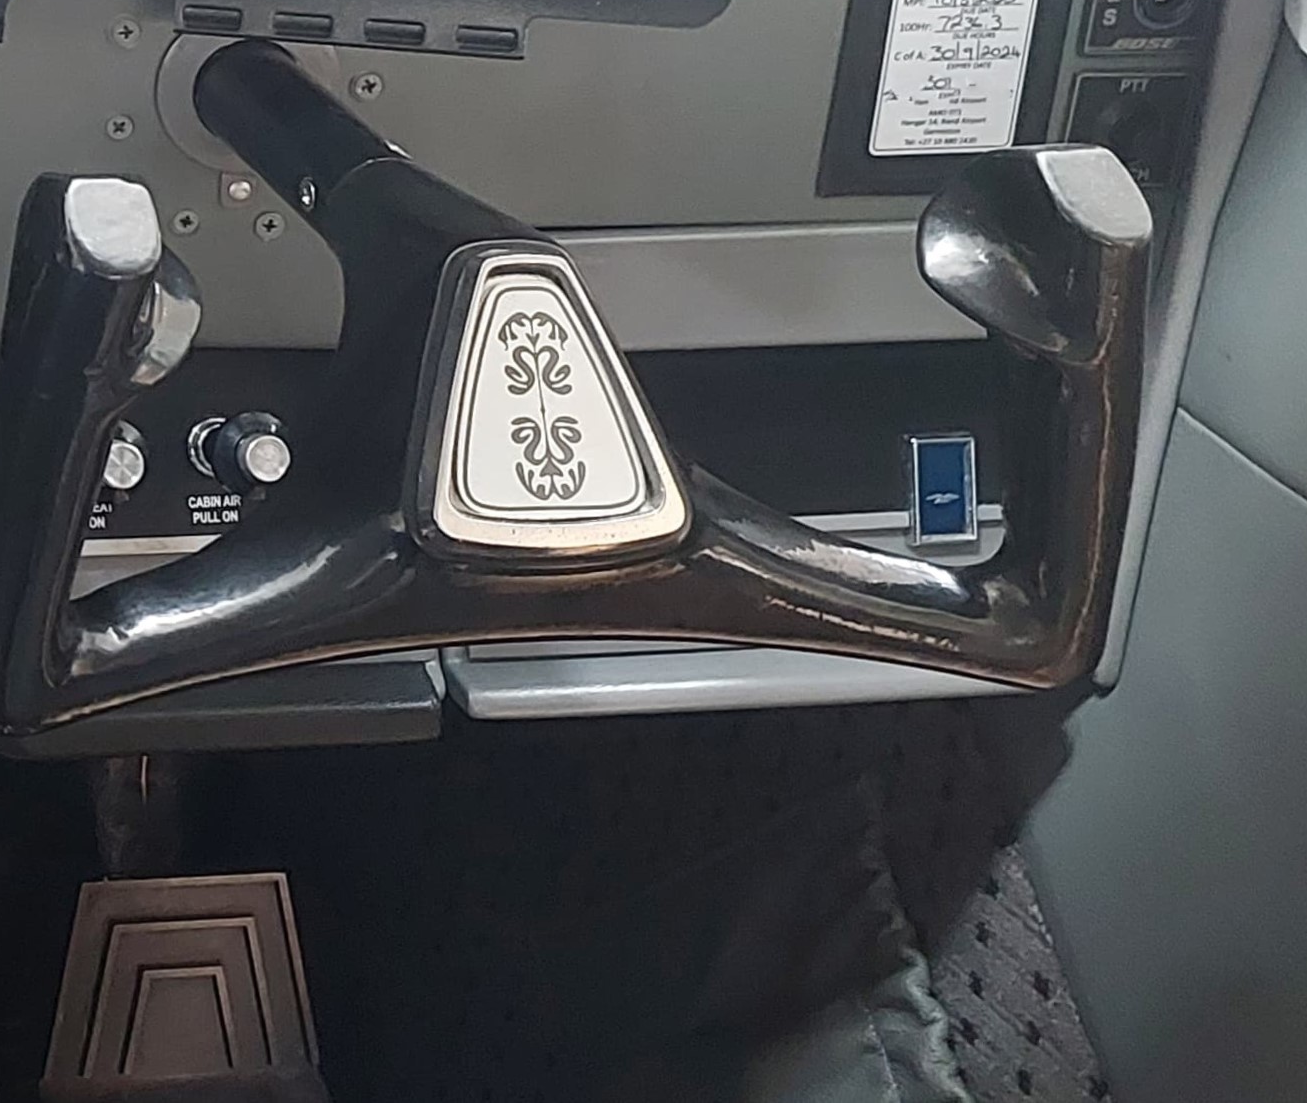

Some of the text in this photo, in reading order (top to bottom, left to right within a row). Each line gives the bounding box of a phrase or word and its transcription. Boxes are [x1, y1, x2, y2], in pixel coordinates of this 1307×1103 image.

[188, 495, 242, 509] CABIN AIR
[192, 510, 239, 524] PULL ON
